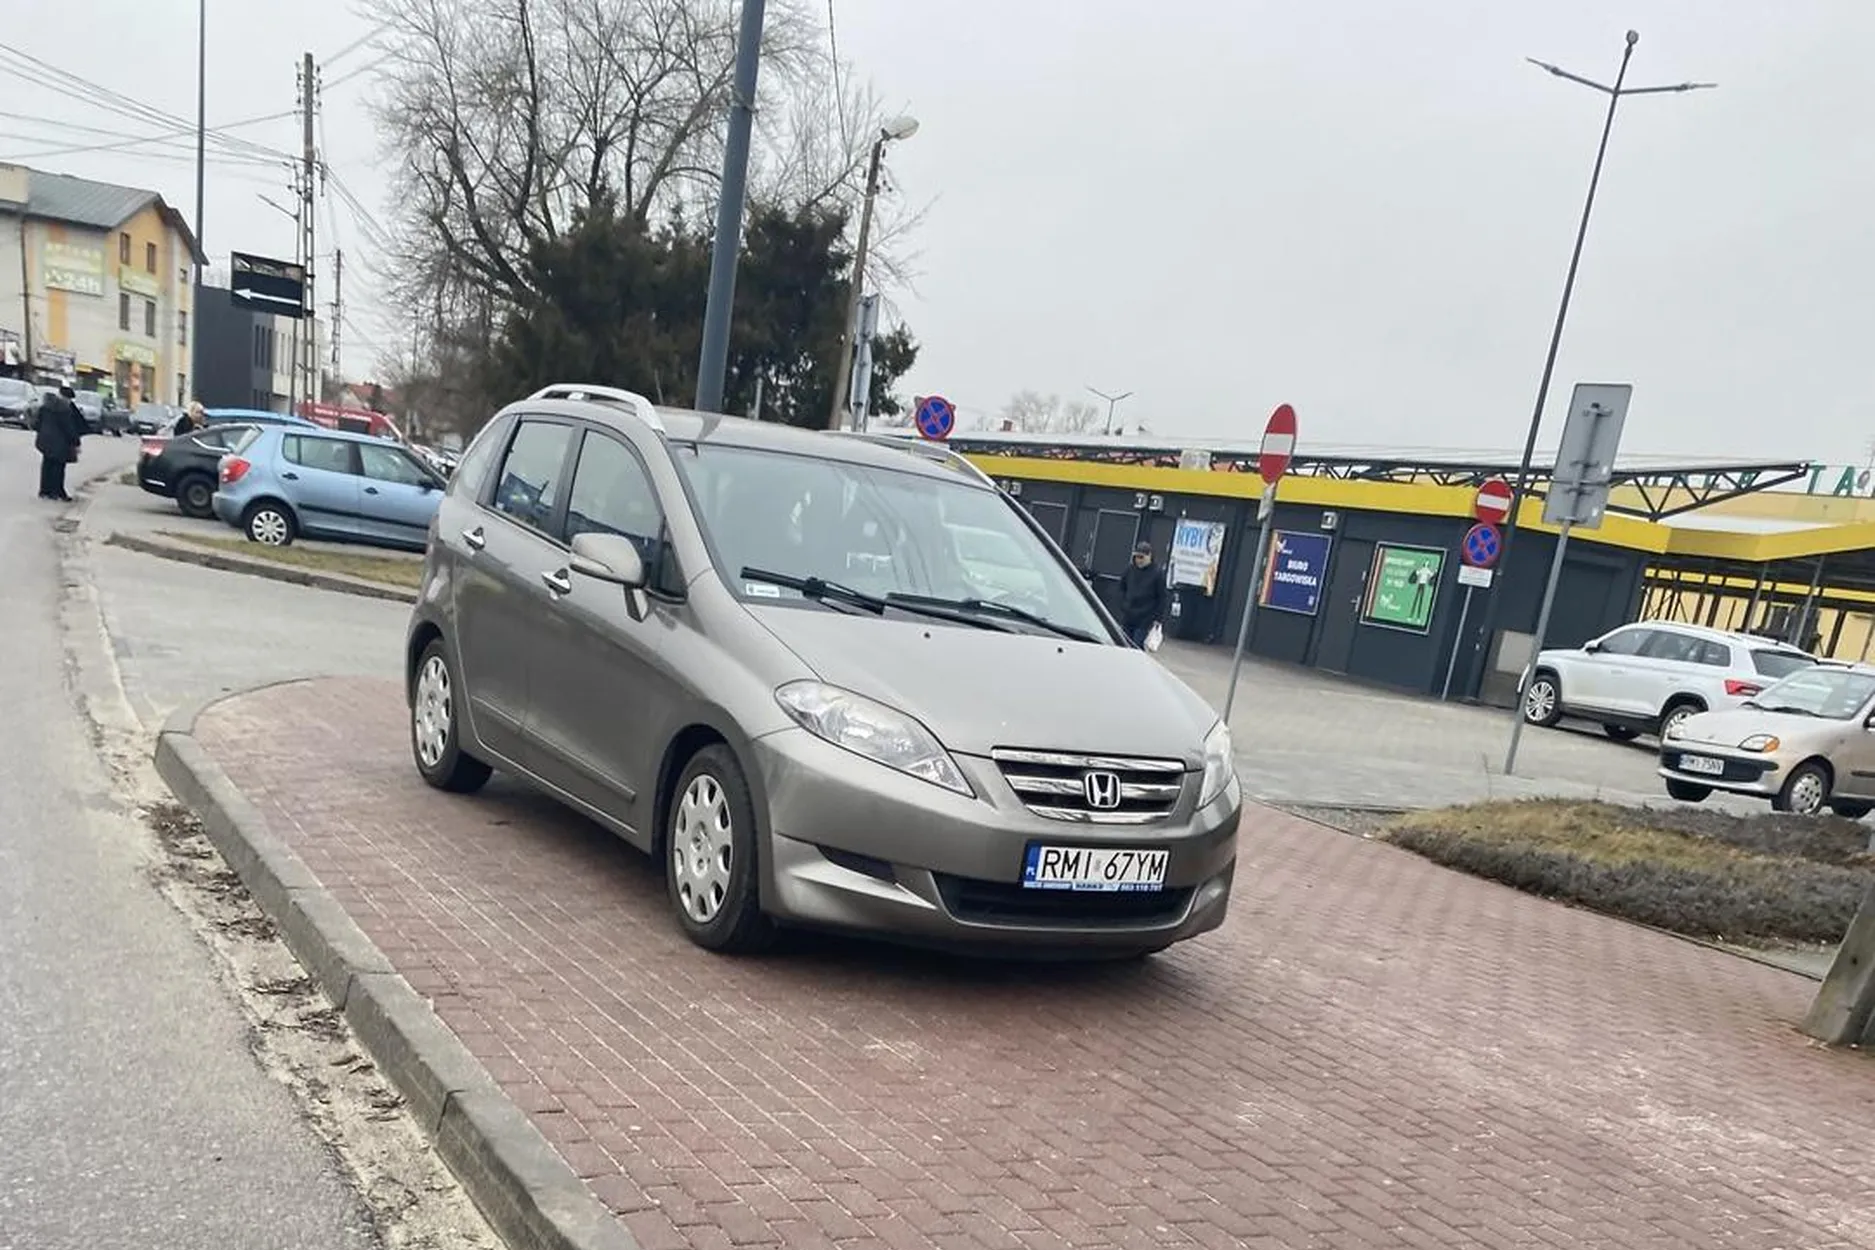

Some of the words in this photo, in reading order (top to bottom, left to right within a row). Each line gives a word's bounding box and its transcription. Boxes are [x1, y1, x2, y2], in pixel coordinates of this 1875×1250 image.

[1177, 527, 1206, 549] RYBY
[1041, 850, 1092, 879] RMI
[1104, 852, 1165, 881] 67YM
